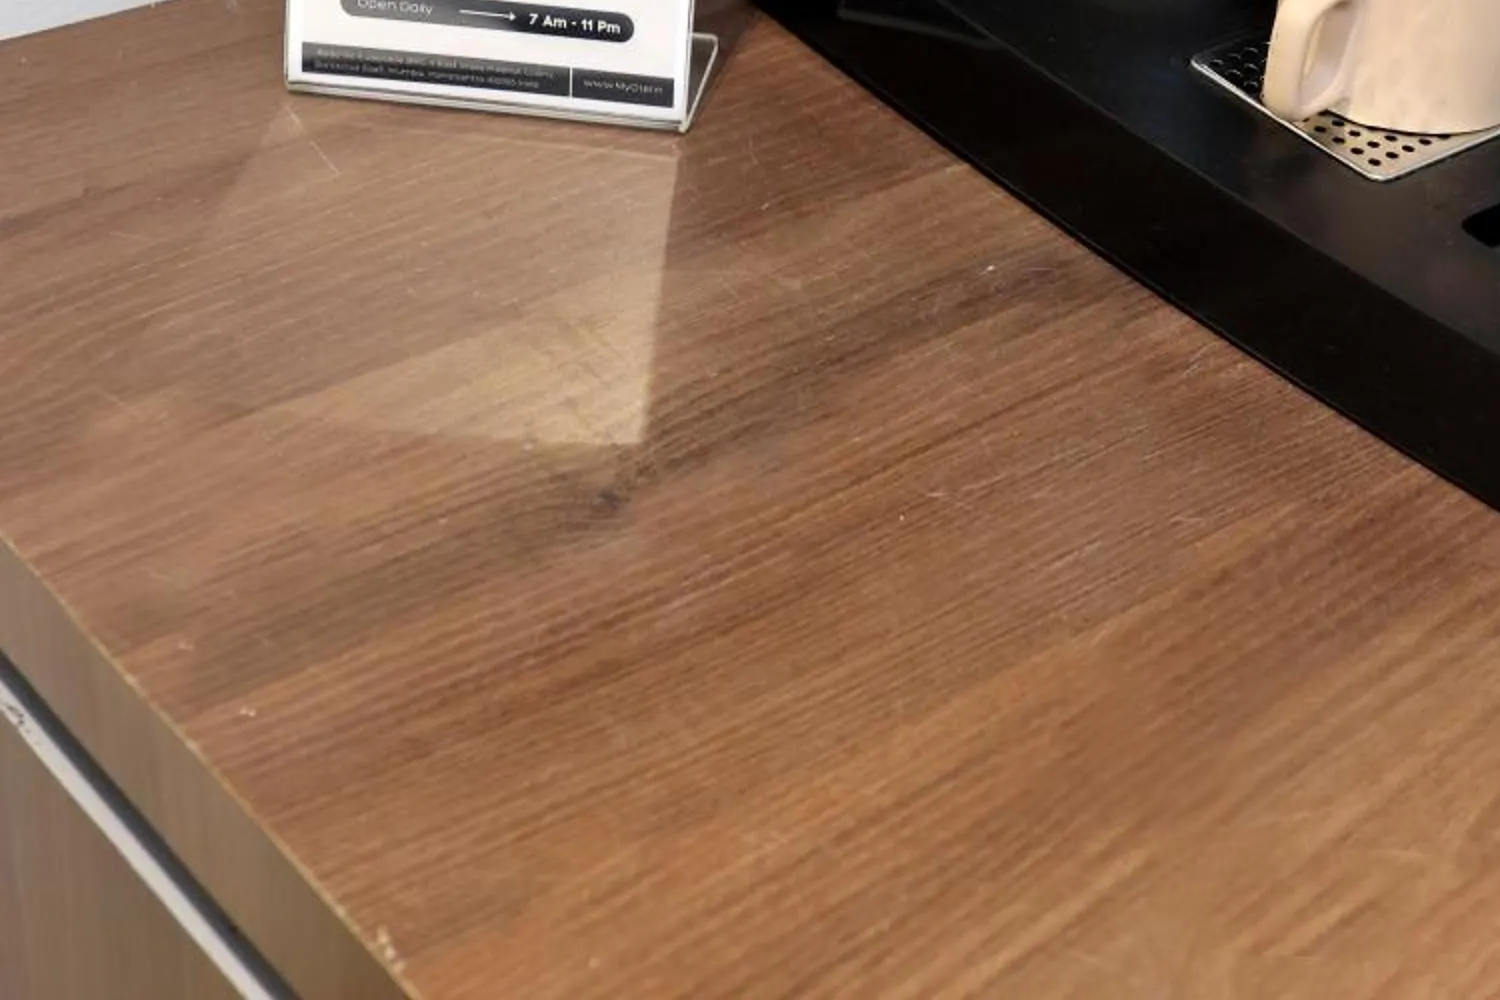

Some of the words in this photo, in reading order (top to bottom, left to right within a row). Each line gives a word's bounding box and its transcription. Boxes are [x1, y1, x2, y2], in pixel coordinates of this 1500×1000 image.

[528, 13, 538, 25] 7
[542, 15, 567, 29] Am
[581, 18, 594, 31] 11
[597, 20, 621, 34] Pm
